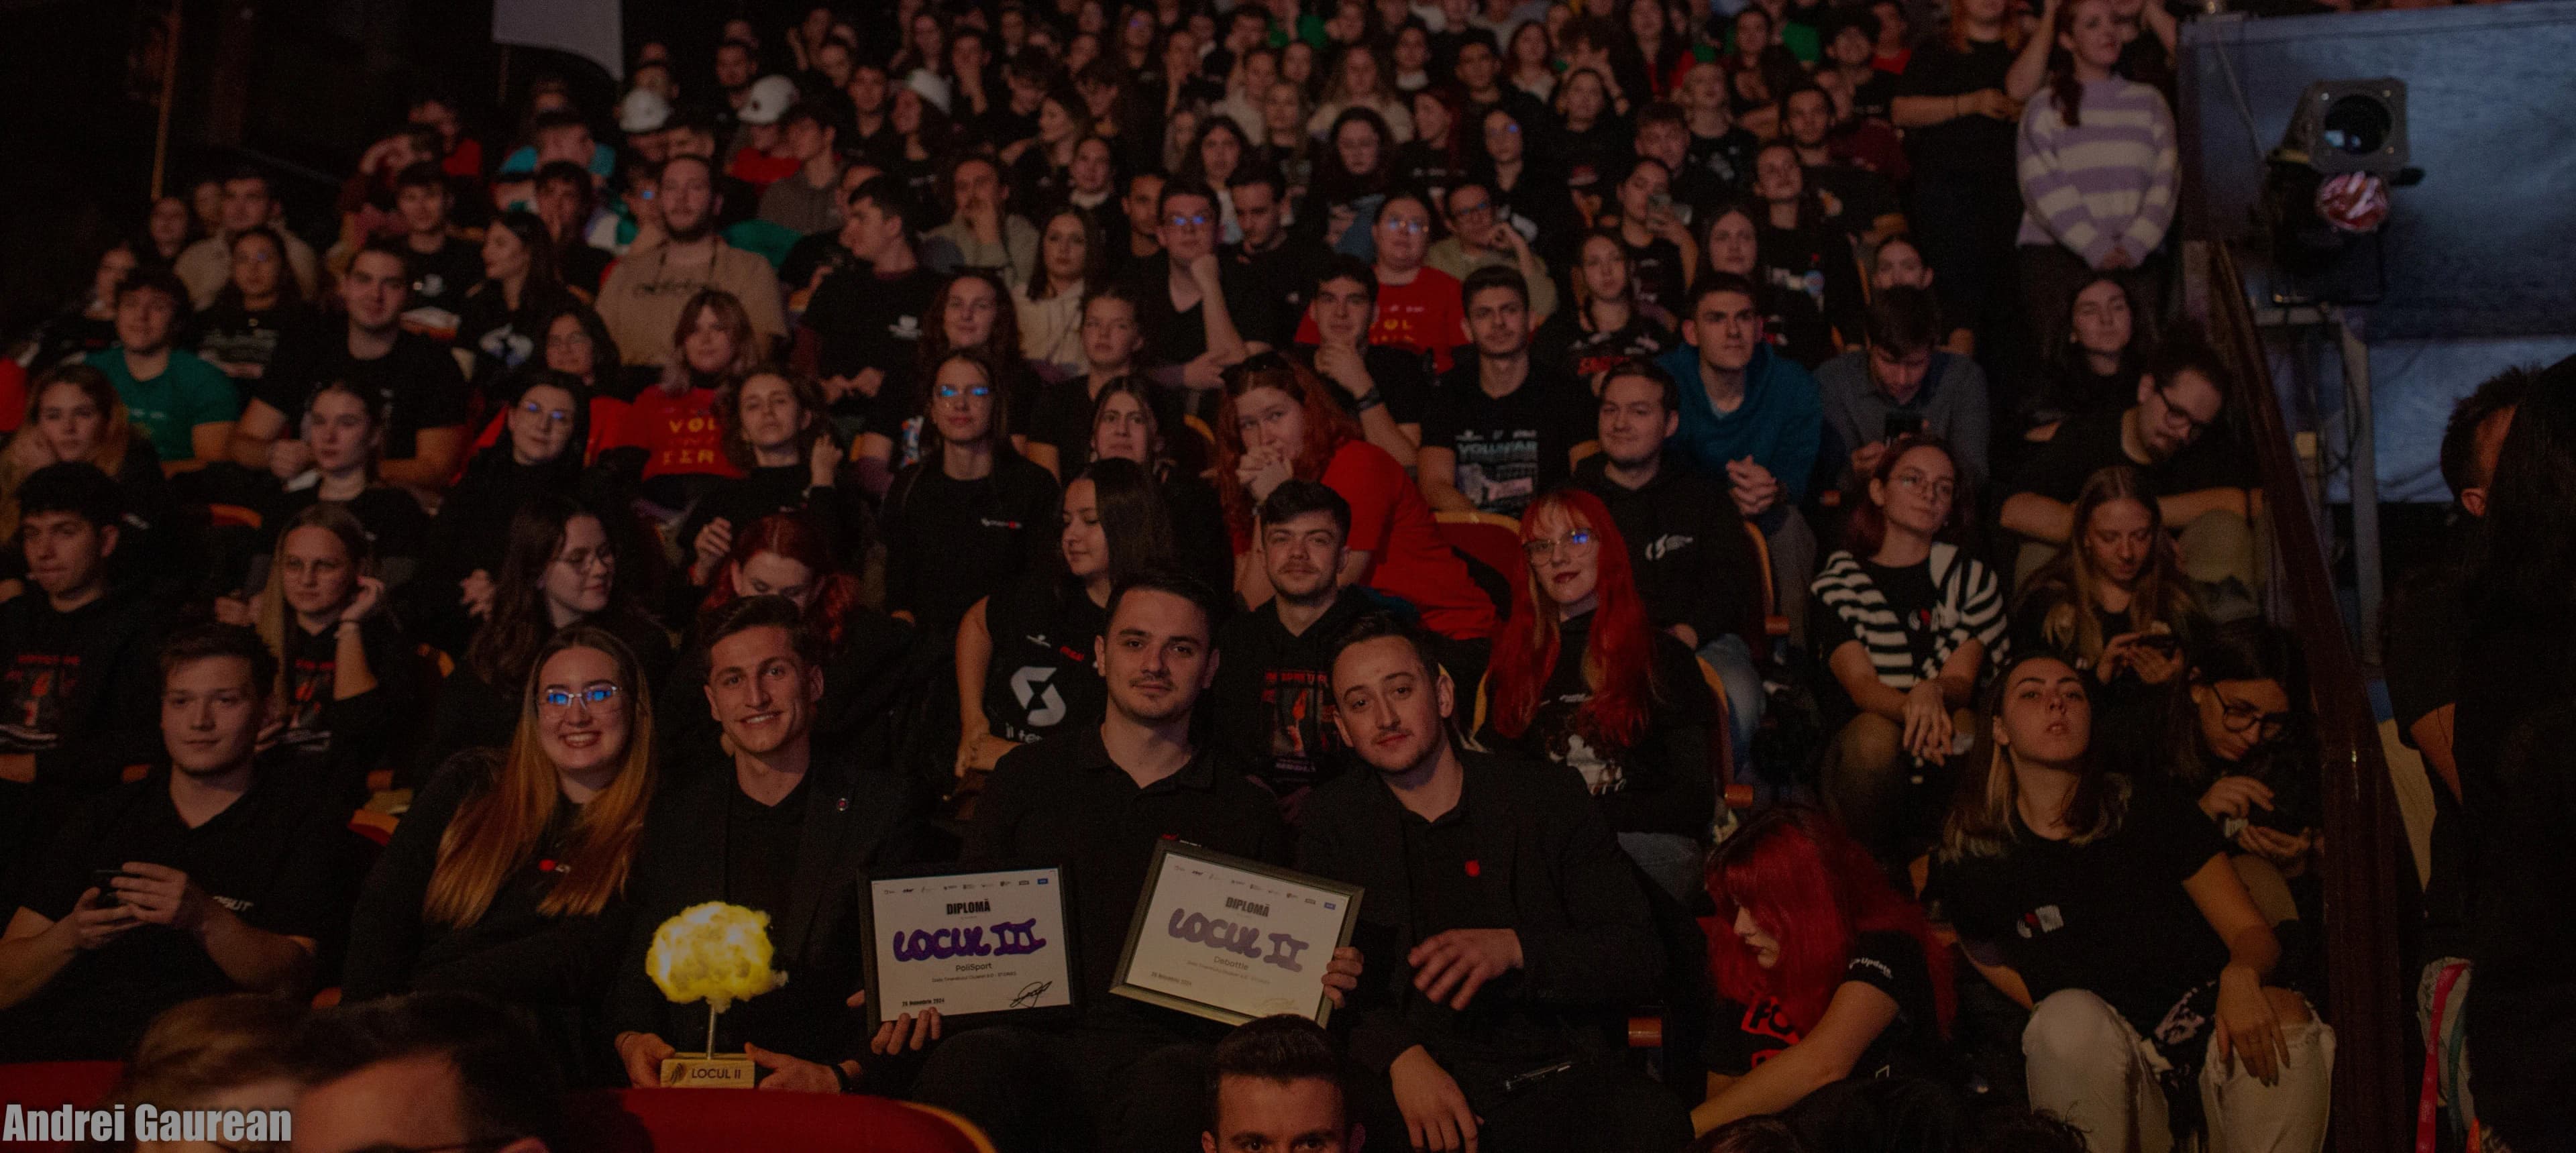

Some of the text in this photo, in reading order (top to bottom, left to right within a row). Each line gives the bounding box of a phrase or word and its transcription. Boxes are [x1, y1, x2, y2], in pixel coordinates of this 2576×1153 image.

[947, 899, 991, 915] DIPLOMĂ
[1225, 897, 1270, 917] DIPLOMĂ
[894, 918, 1046, 961] LOCUL III
[956, 963, 992, 971] PoliSport
[692, 1068, 741, 1079] LOCUL II
